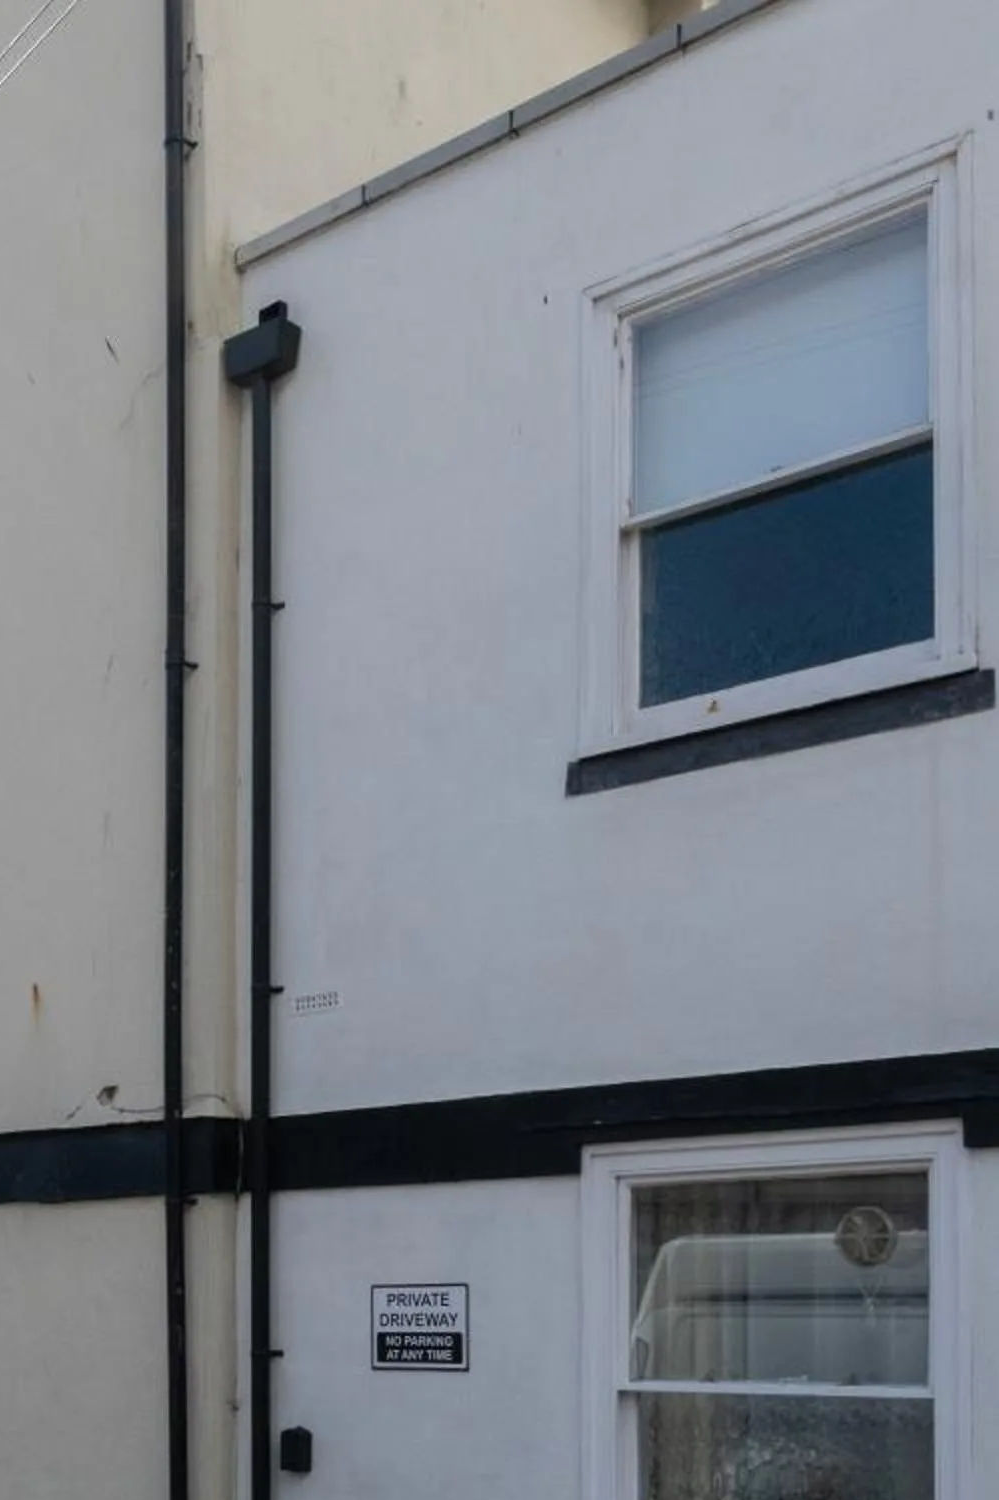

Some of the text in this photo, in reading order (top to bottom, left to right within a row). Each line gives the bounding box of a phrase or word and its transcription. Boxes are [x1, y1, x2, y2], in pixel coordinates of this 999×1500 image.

[386, 1293, 450, 1307] PRIVATE
[379, 1312, 458, 1327] DRIVEWAY
[386, 1336, 454, 1347] NO PARKING
[386, 1349, 453, 1361] AT ANY TIME
